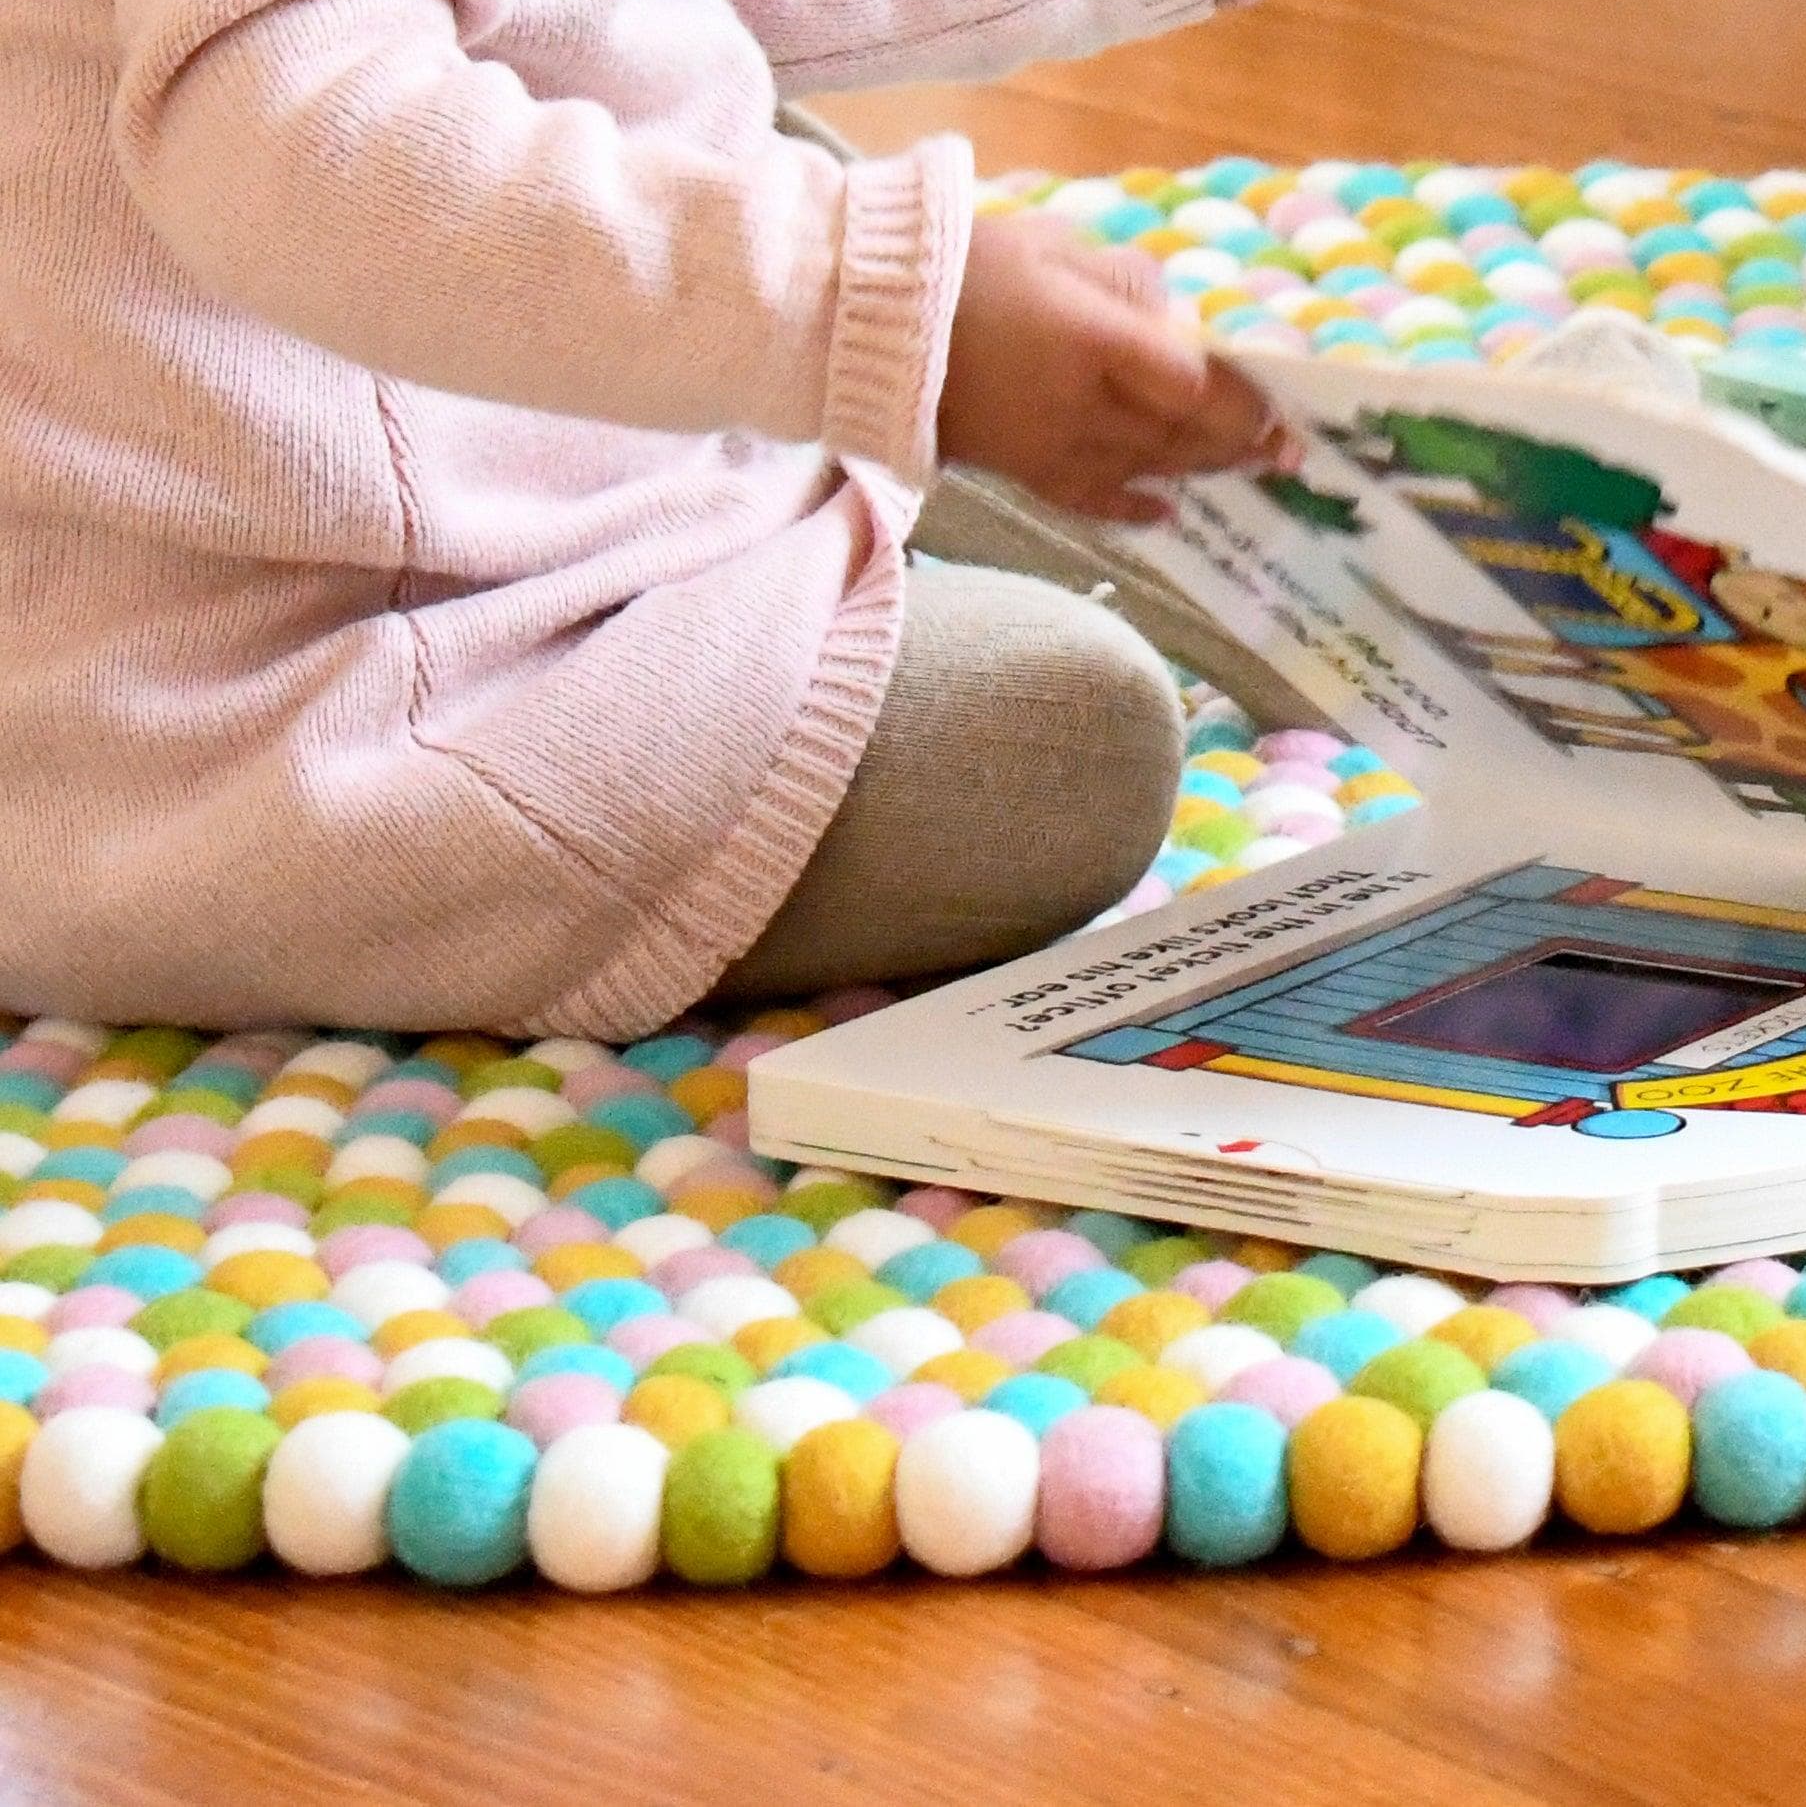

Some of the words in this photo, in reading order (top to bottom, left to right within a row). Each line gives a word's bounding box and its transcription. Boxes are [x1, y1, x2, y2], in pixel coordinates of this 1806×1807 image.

[1284, 870, 1377, 900] That
[1387, 870, 1432, 883] Is
[1341, 884, 1400, 901] he
[1188, 898, 1298, 935] looks
[1303, 902, 1353, 916] in
[1243, 917, 1315, 940] the
[1121, 935, 1202, 961] like
[1065, 961, 1133, 981] his
[1135, 941, 1252, 981] ticket
[1004, 982, 1138, 1032] office?
[1636, 1078, 1759, 1101] ZOO
